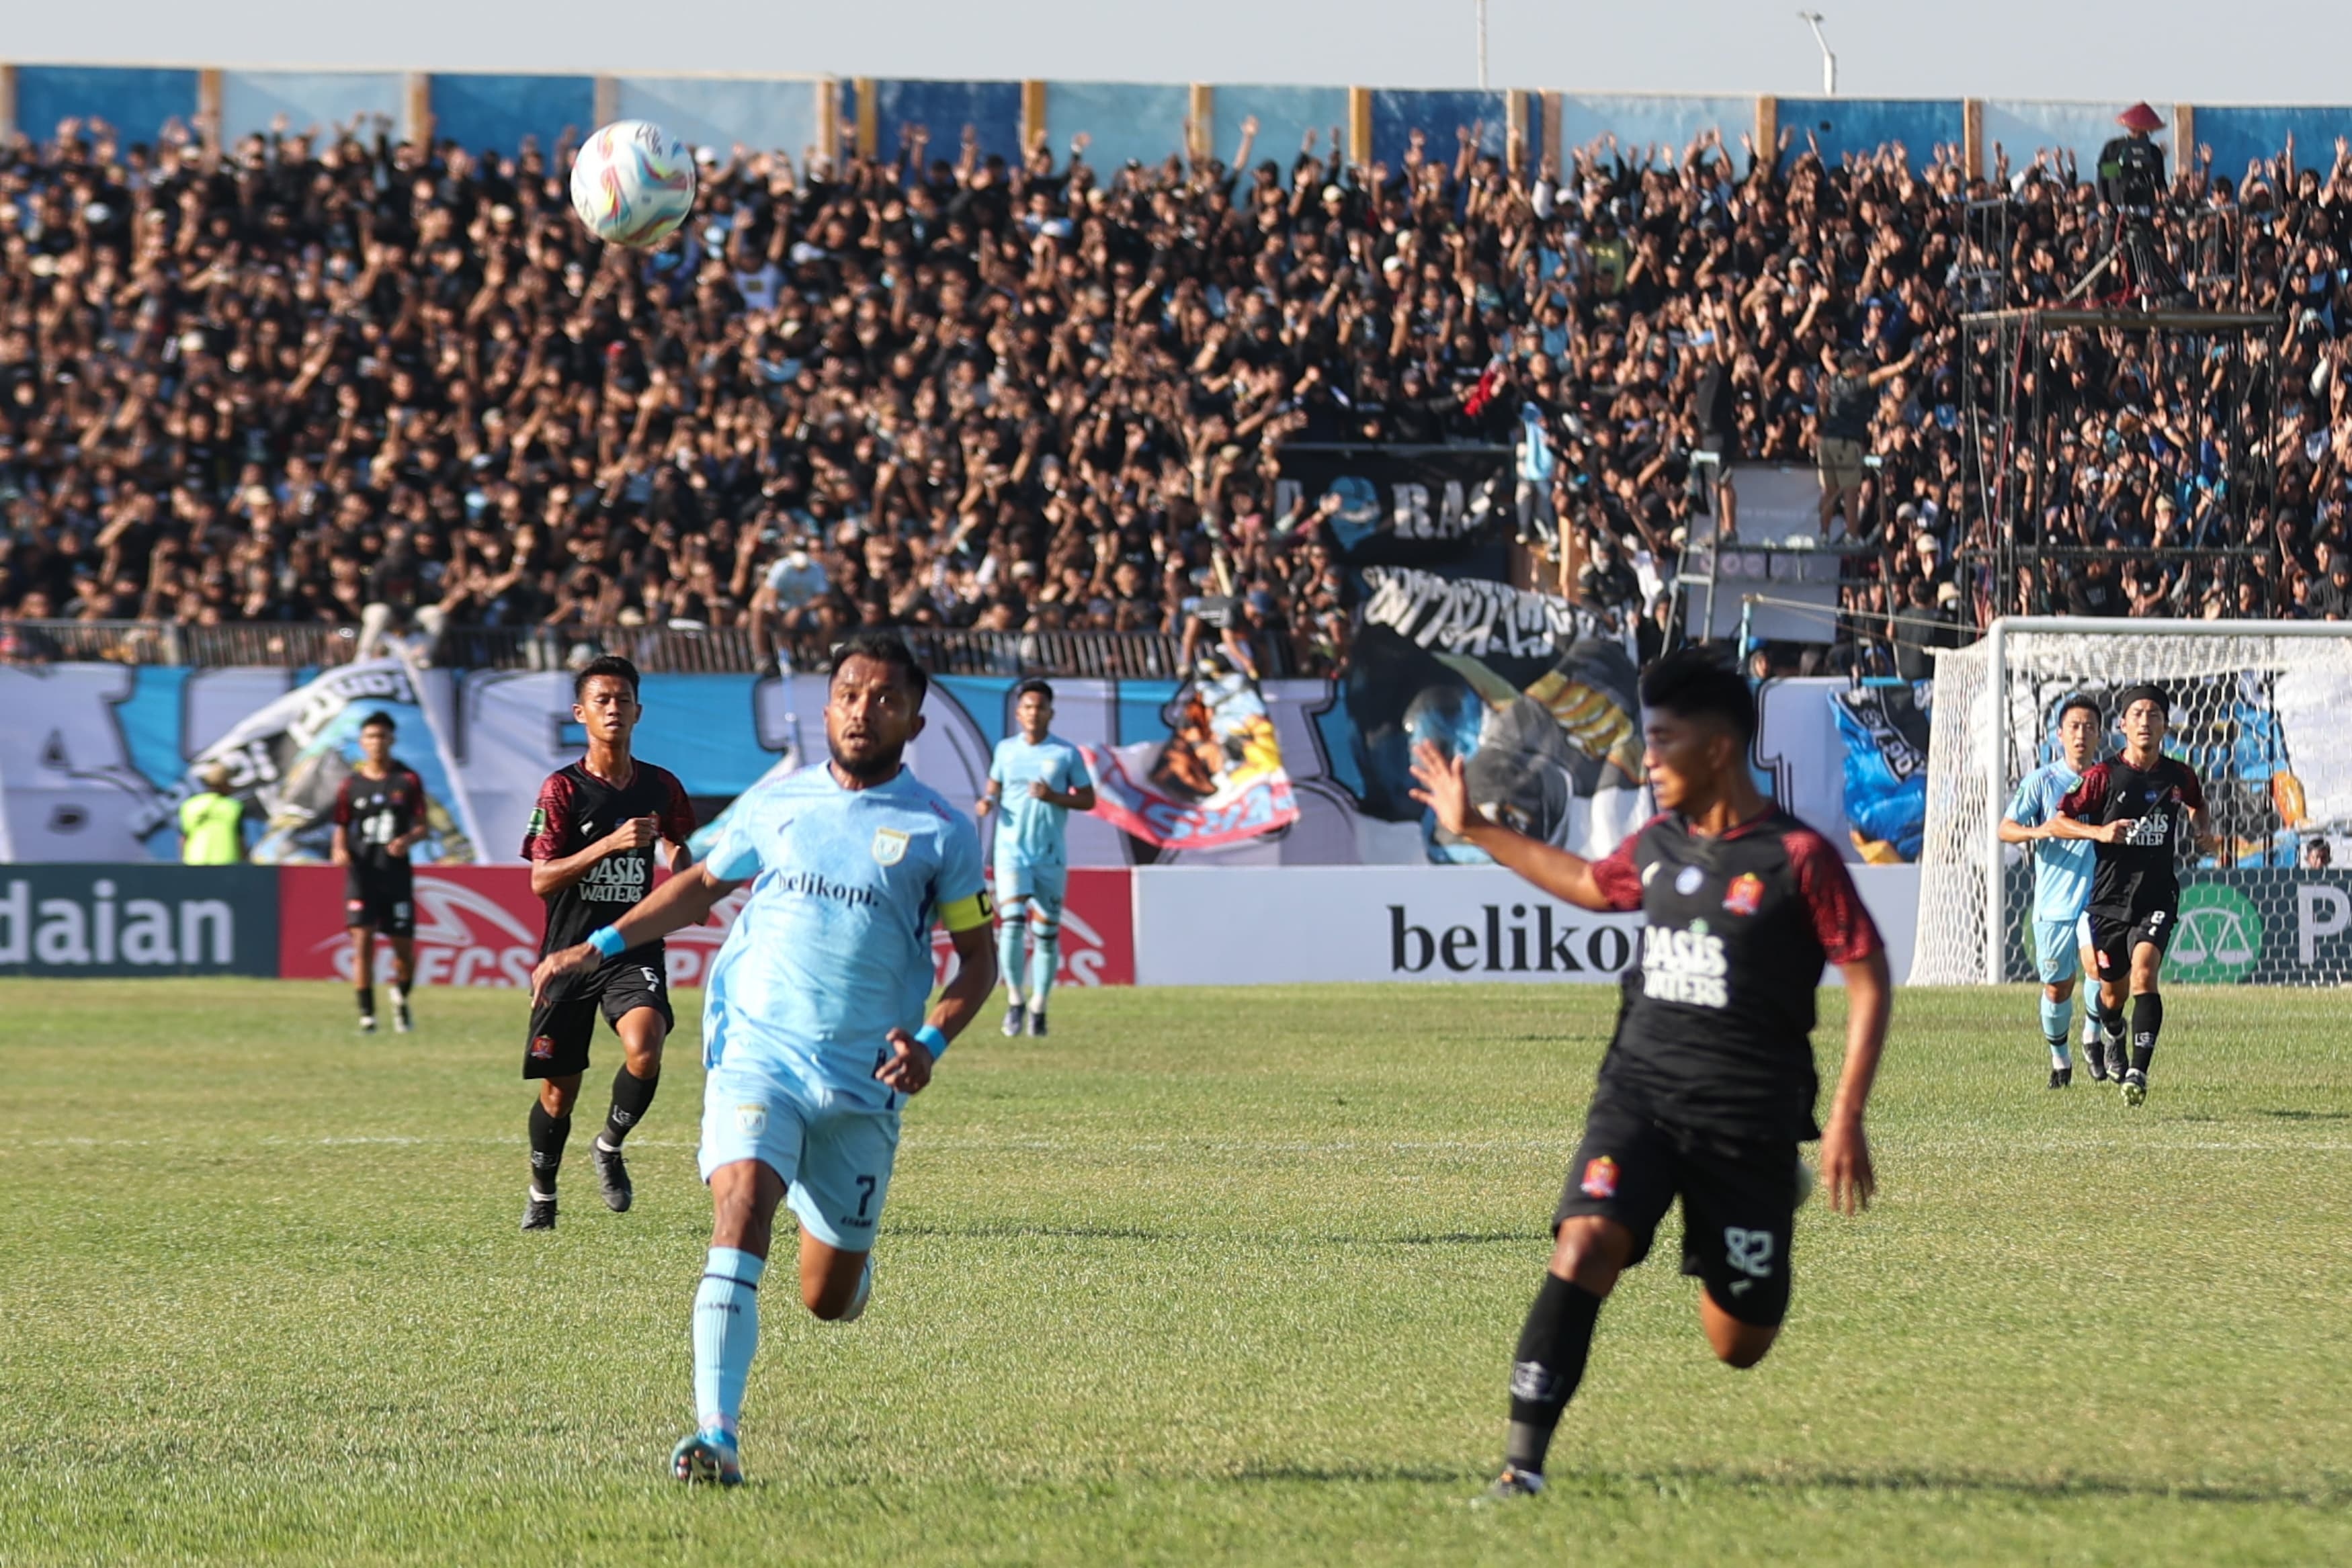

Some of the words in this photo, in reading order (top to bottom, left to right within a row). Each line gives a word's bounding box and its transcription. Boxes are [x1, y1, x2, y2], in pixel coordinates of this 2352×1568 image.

[579, 883, 644, 904] WATERS
[778, 871, 879, 908] belikopi.
[0, 879, 233, 965] daian
[1386, 904, 1646, 973] beliko
[2297, 884, 2351, 965] P
[856, 1174, 876, 1217] 7
[1724, 1227, 1773, 1276] 82
